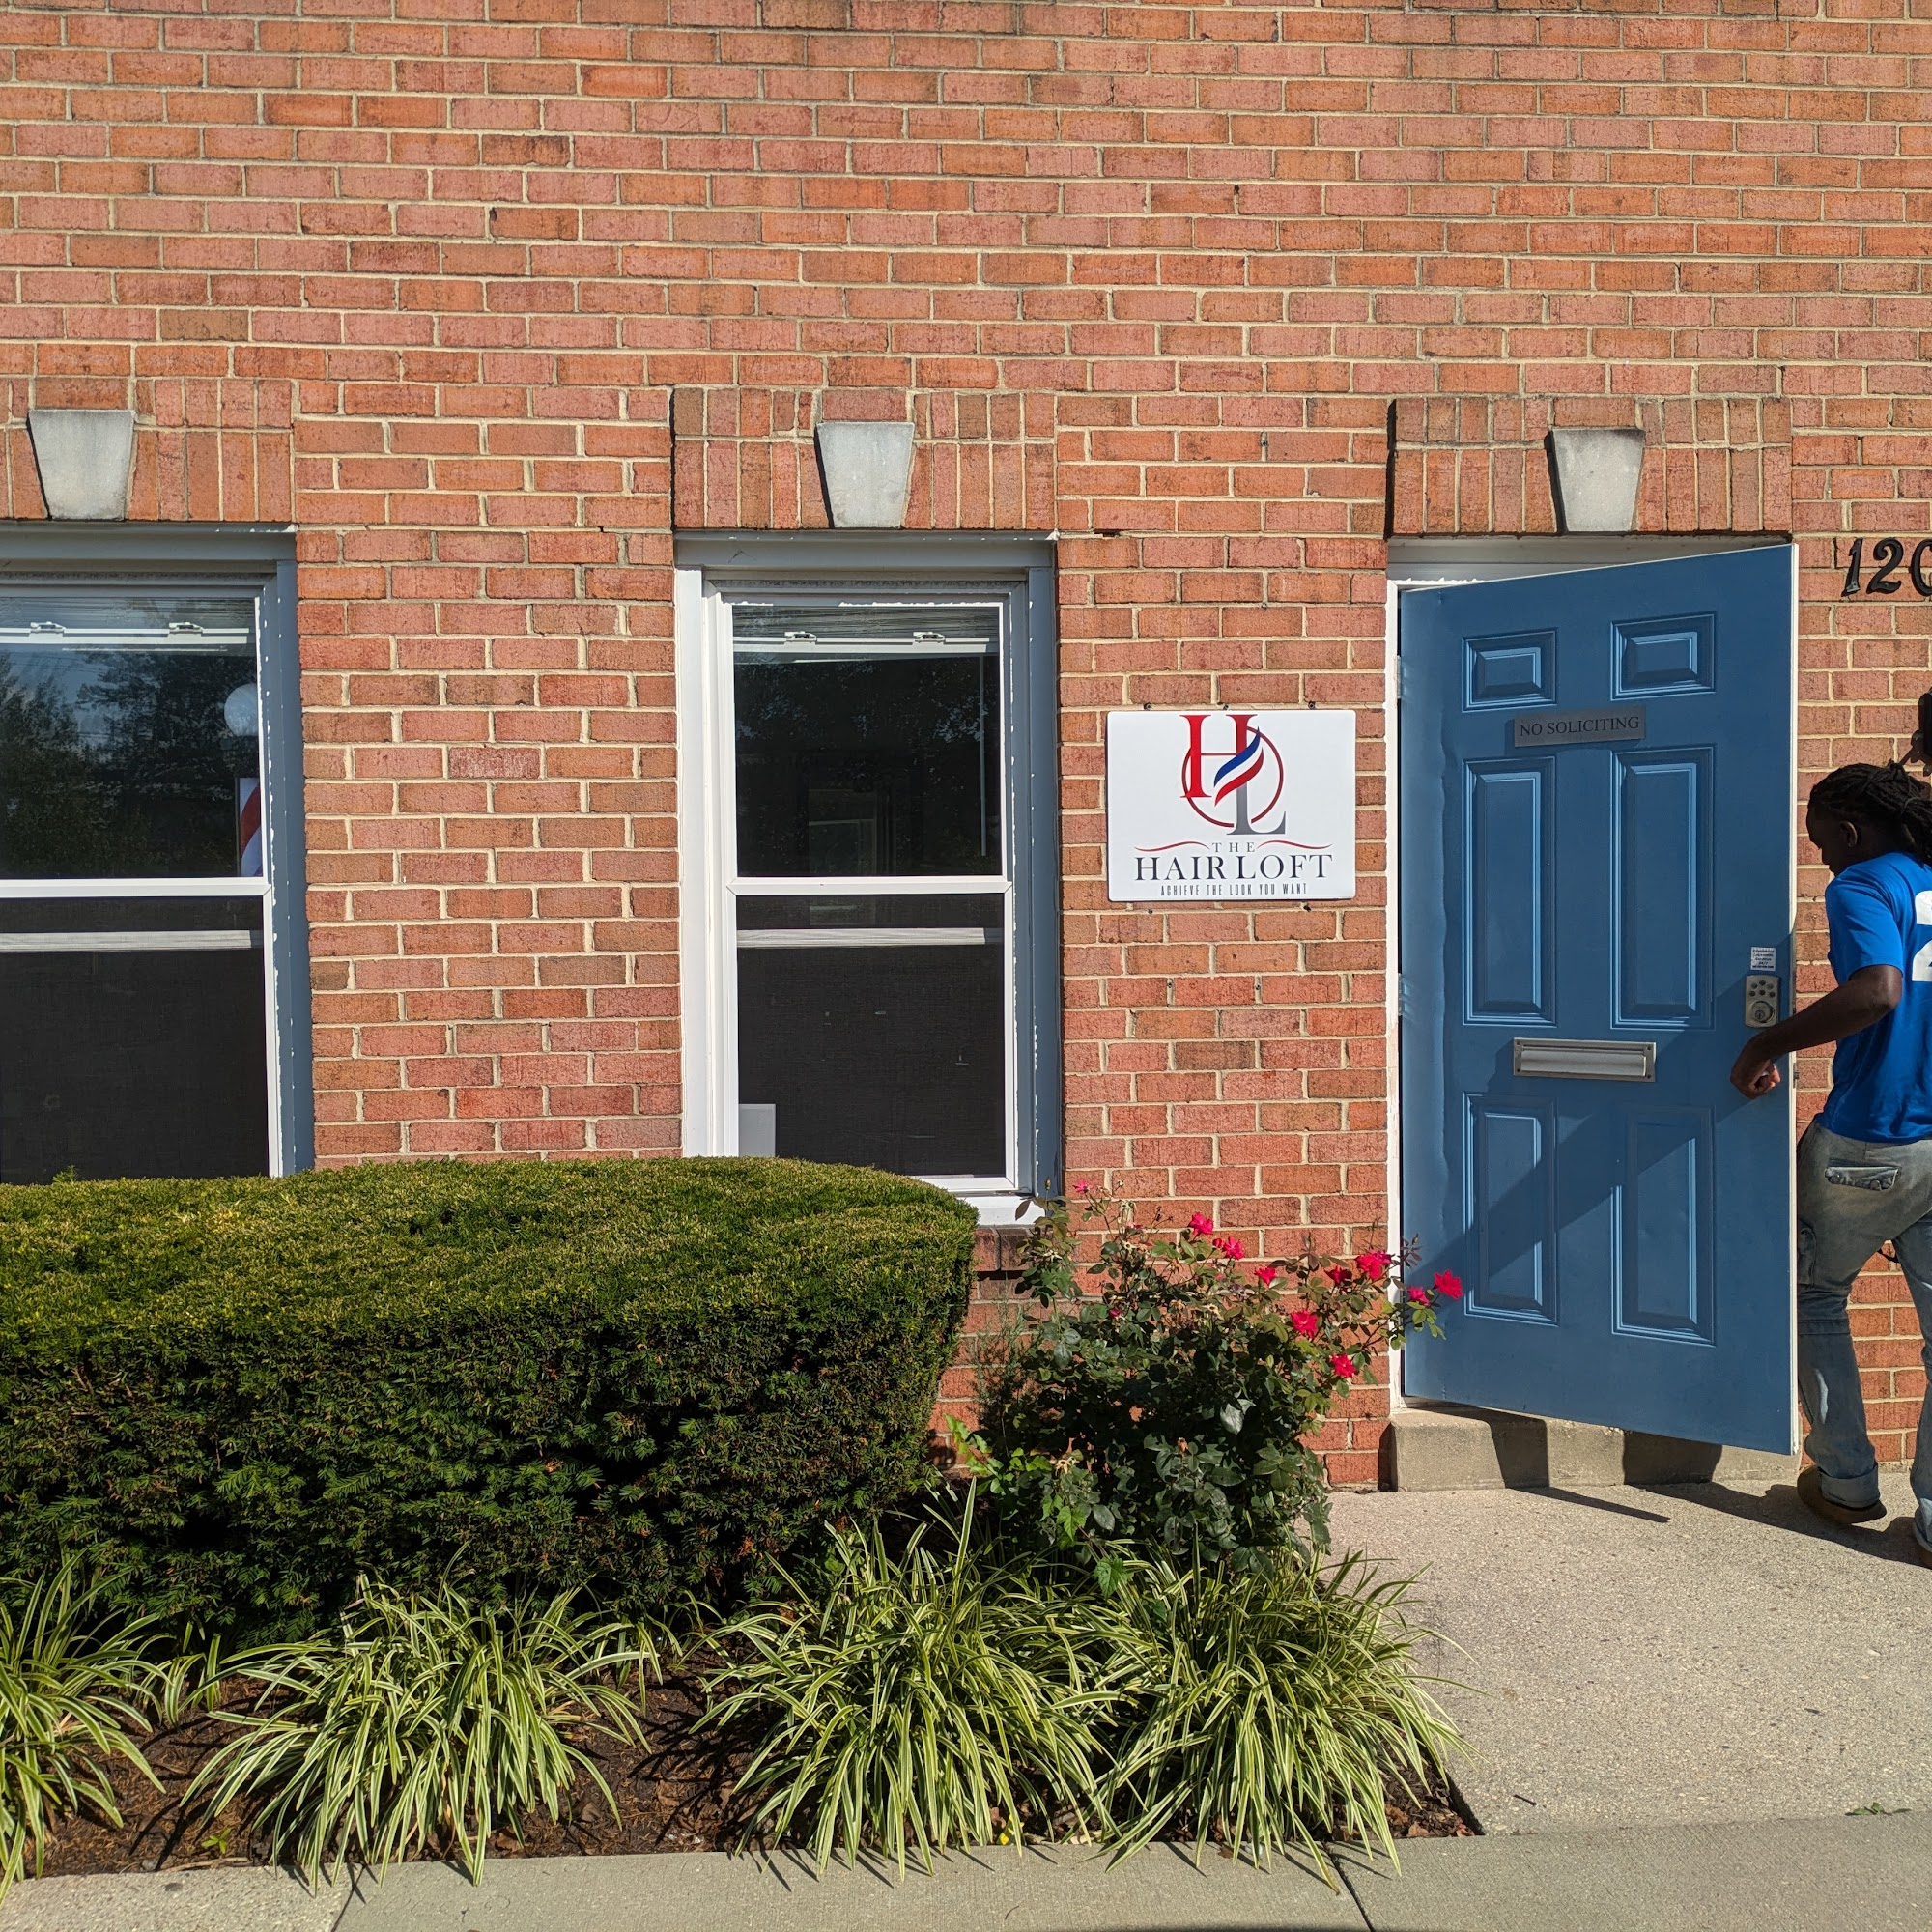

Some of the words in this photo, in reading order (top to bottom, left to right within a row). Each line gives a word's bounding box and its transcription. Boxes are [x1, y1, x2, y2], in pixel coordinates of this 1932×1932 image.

[1520, 723, 1543, 736] NO
[1547, 716, 1639, 735] SOLICITING
[1212, 842, 1255, 852] THE
[1134, 856, 1227, 880] HAIR
[1236, 854, 1333, 879] LOFT
[1161, 885, 1200, 896] ACHIEVE
[1207, 884, 1222, 895] THE
[1230, 884, 1252, 895] LOOK
[1260, 884, 1276, 895] YOU
[1283, 883, 1307, 895] WANT
